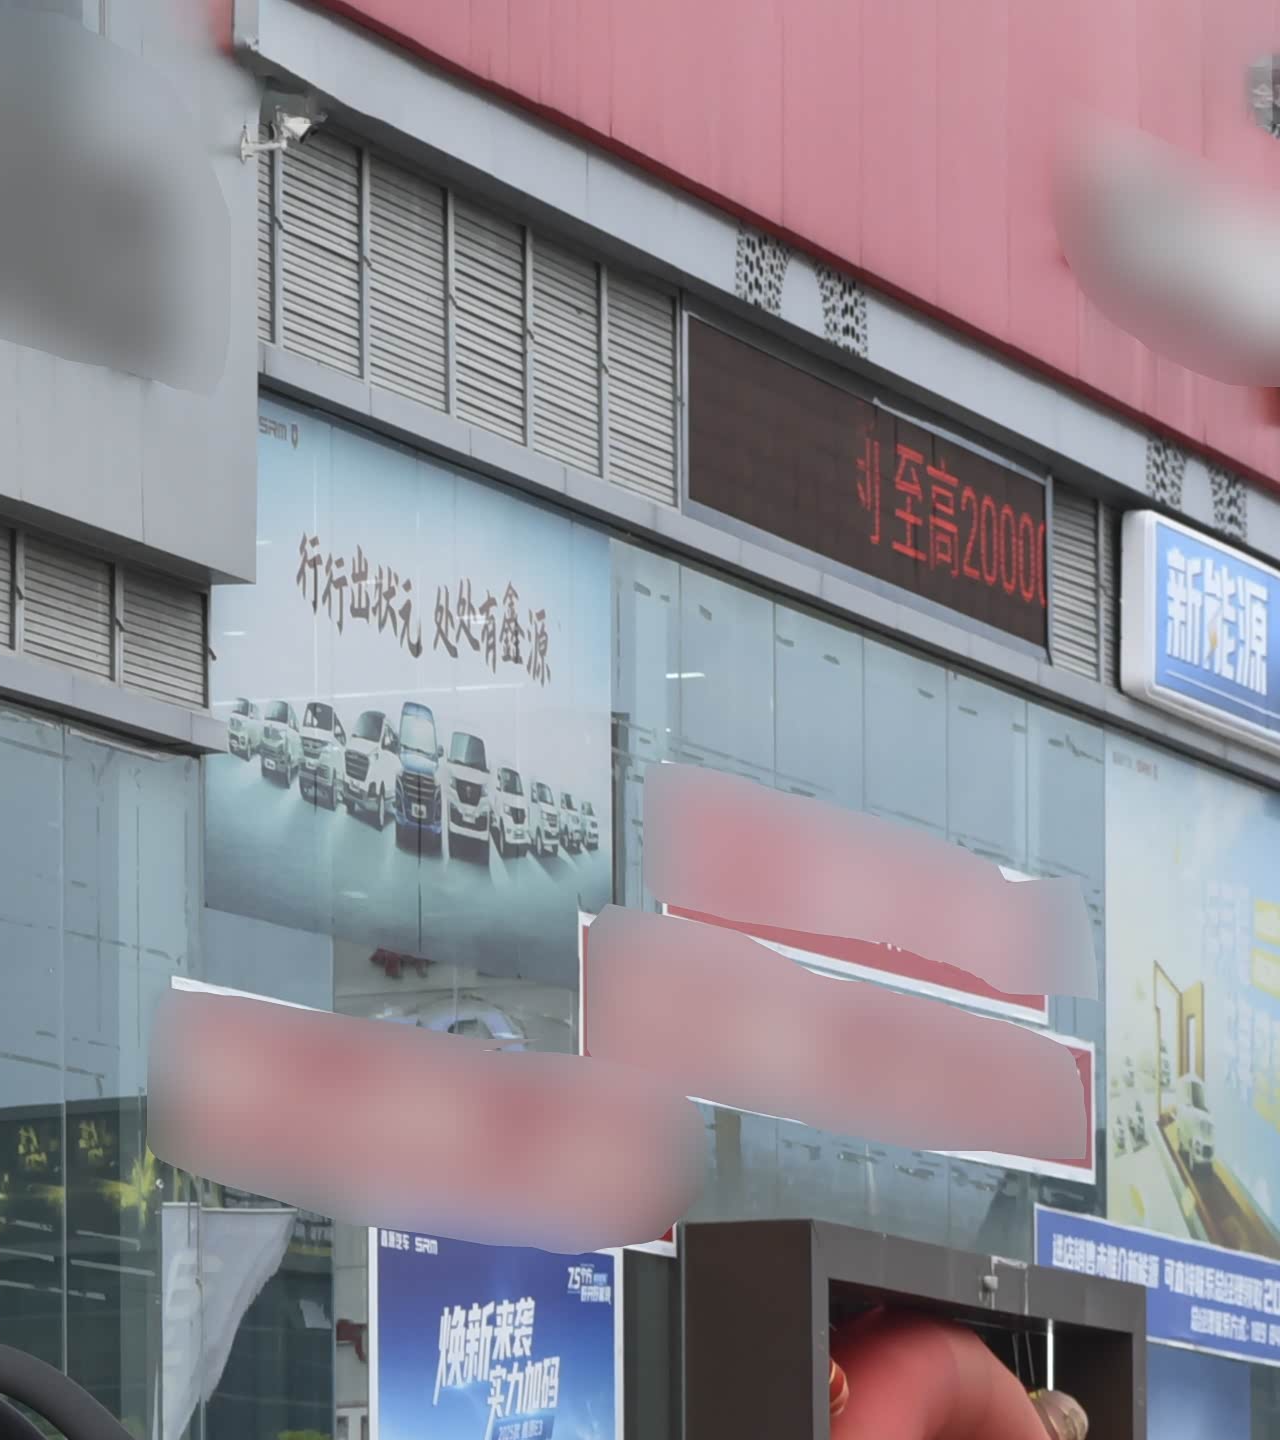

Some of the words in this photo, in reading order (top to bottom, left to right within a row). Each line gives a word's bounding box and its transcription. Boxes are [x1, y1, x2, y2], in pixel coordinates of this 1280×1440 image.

[297, 533, 422, 658] 行行出状元
[433, 580, 551, 687] 处处有鑫源
[1166, 547, 1268, 695] 新能源
[433, 1296, 536, 1407] 焕新来袭
